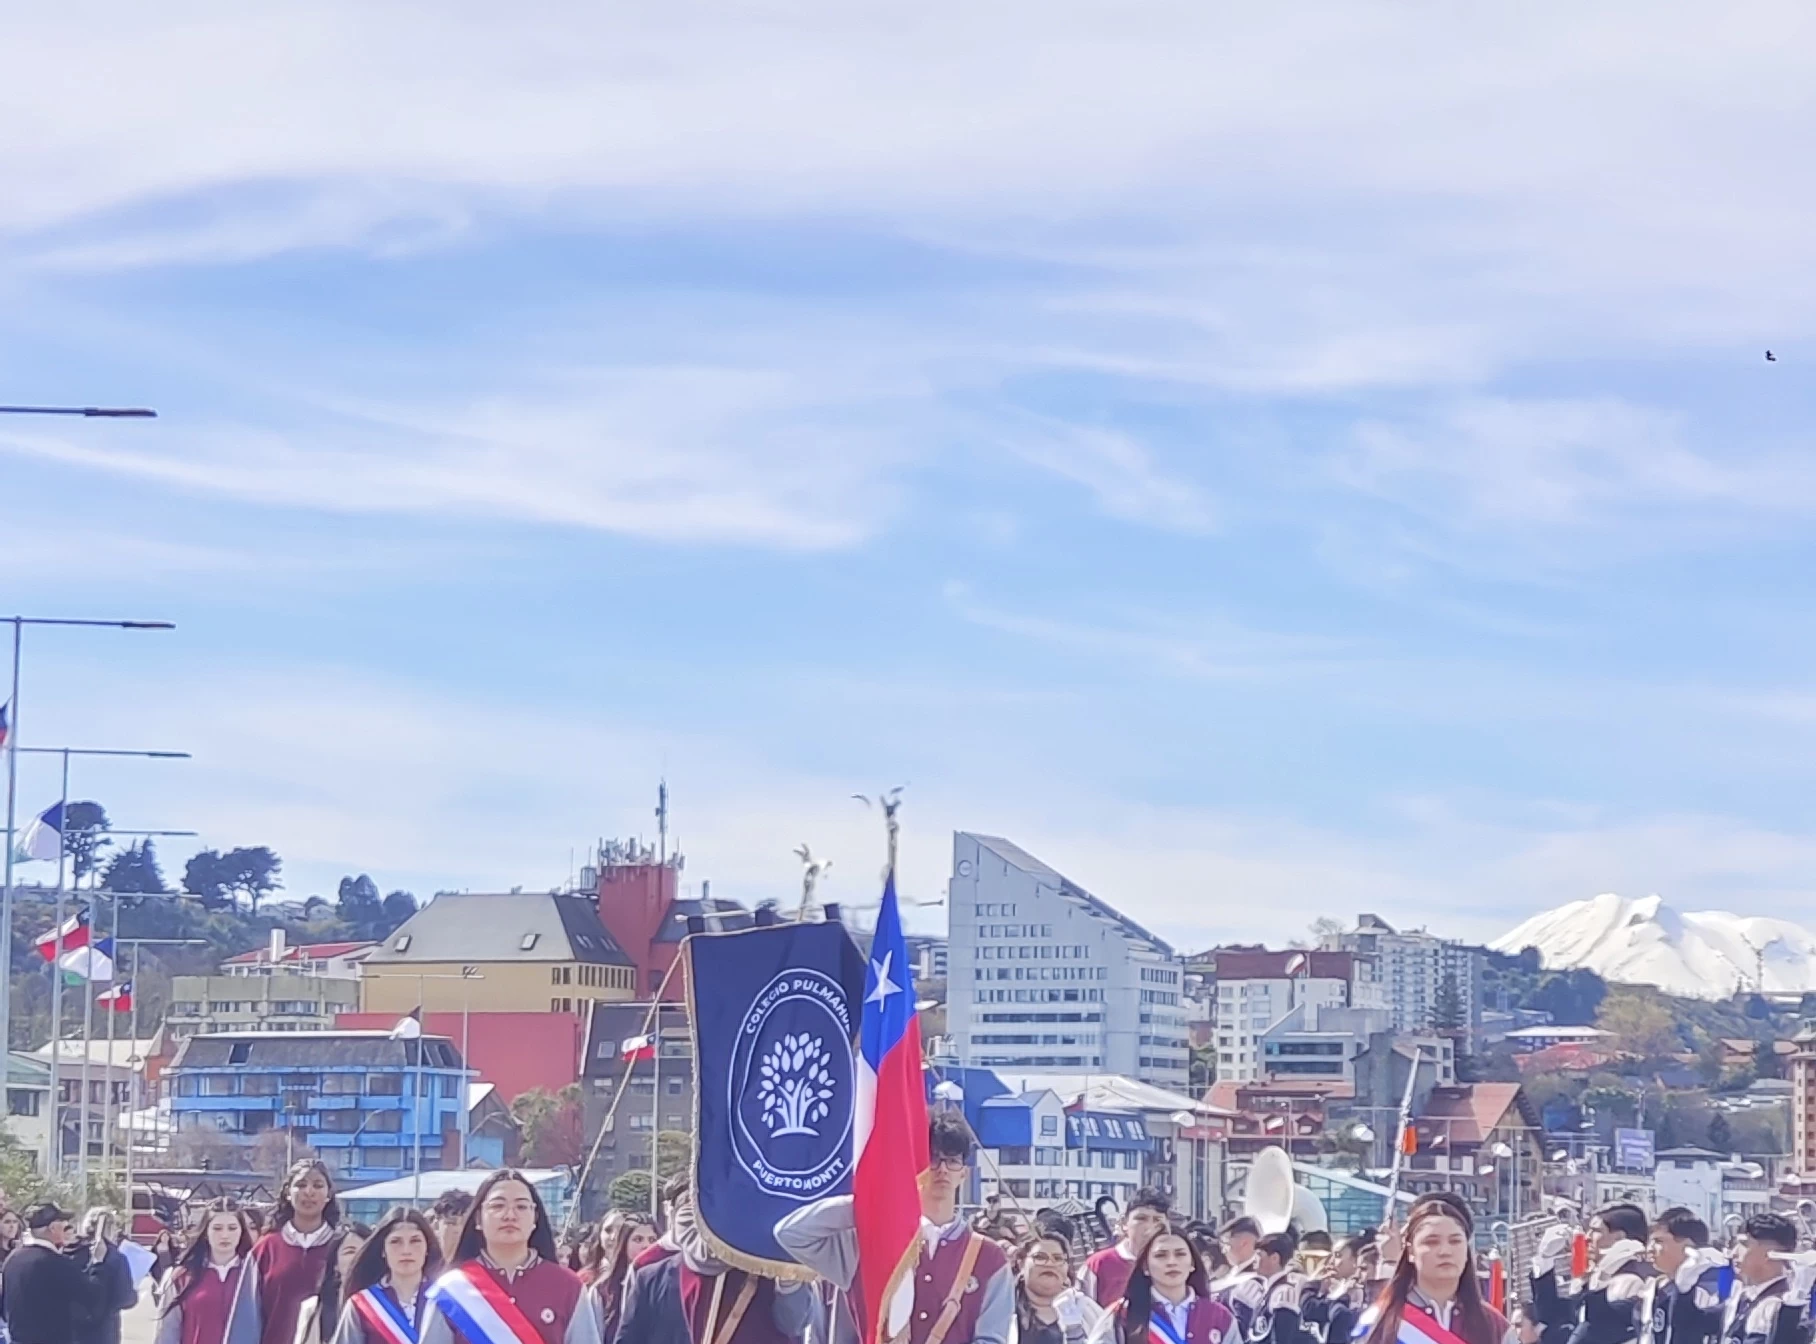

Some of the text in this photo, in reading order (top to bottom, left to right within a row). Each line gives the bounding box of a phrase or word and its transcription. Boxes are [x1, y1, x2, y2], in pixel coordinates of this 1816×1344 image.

[746, 982, 789, 1034] COLEGIO
[752, 1157, 844, 1190] PUERTO MONTT
